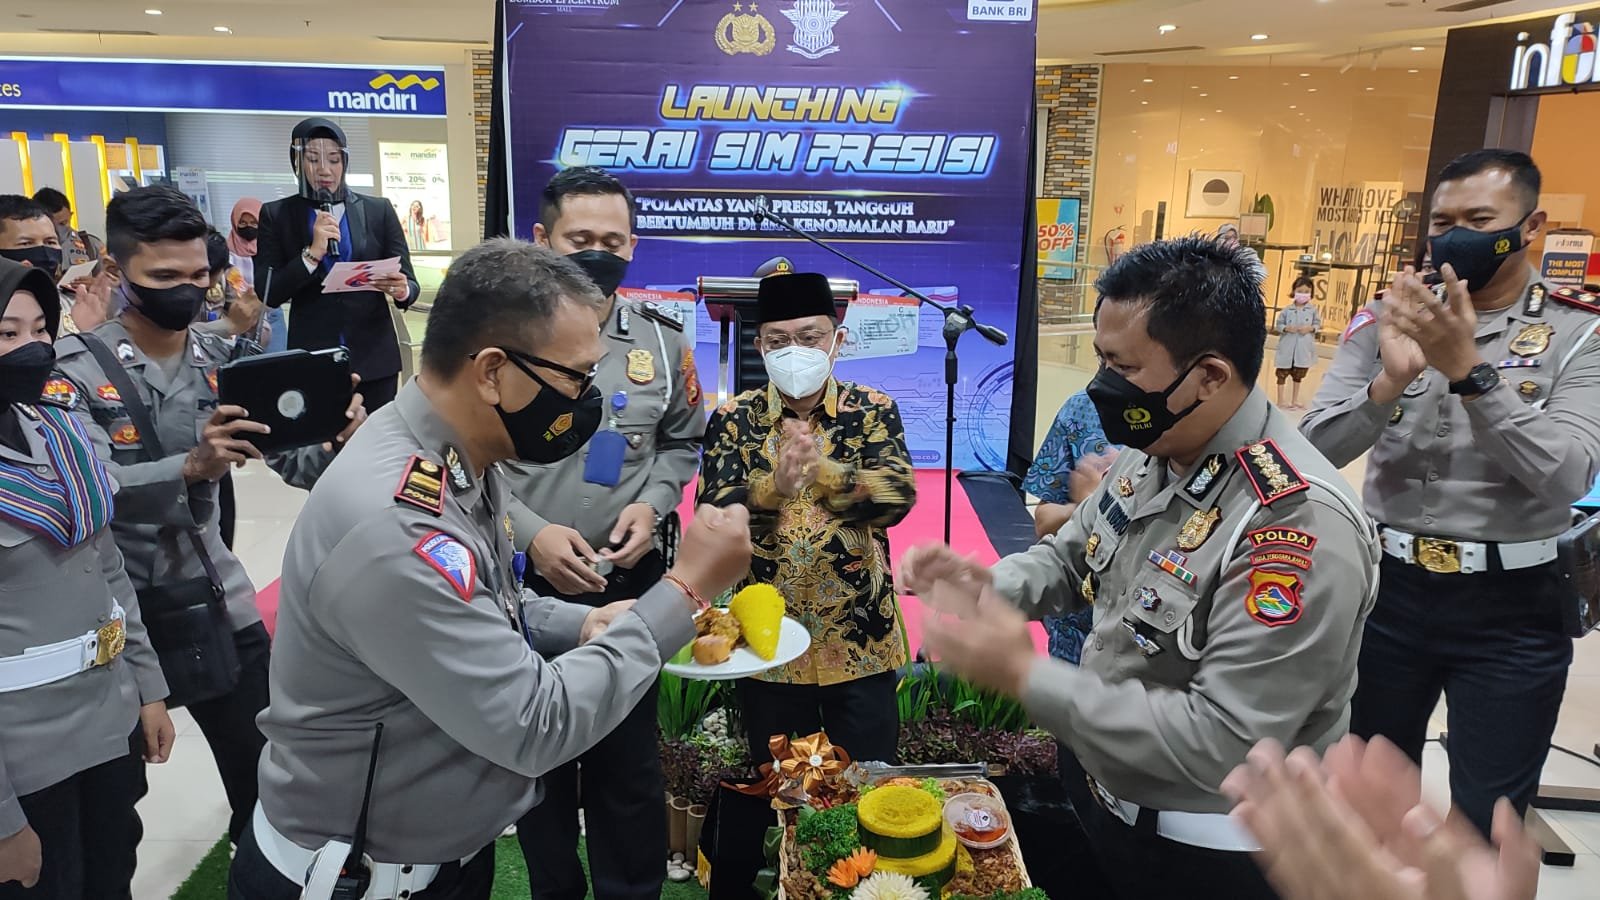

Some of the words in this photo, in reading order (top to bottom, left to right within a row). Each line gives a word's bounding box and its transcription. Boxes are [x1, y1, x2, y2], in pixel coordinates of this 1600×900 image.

[972, 6, 1005, 16] BANK
[1008, 7, 1027, 16] BRI
[0, 82, 22, 97] es
[327, 87, 418, 111] mandiri
[661, 85, 903, 123] LAUNCHING
[560, 129, 699, 169] GERAI
[710, 131, 801, 172] SIM
[803, 132, 997, 176] PRESISI
[724, 199, 768, 213] YAN
[772, 200, 832, 216] PRESISI,
[835, 201, 915, 216] TANGGUH
[636, 215, 735, 231] BERTUMBUH
[793, 218, 904, 234] KENORMALAN
[1038, 223, 1074, 237] 50%
[1038, 237, 1074, 251] OFF
[1548, 260, 1563, 268] THE
[1565, 260, 1586, 268] MOST
[1546, 268, 1584, 277] COMPLETE
[626, 291, 663, 300] INDONESIA
[1130, 422, 1153, 431] POLRI
[1254, 530, 1309, 546] POLDA
